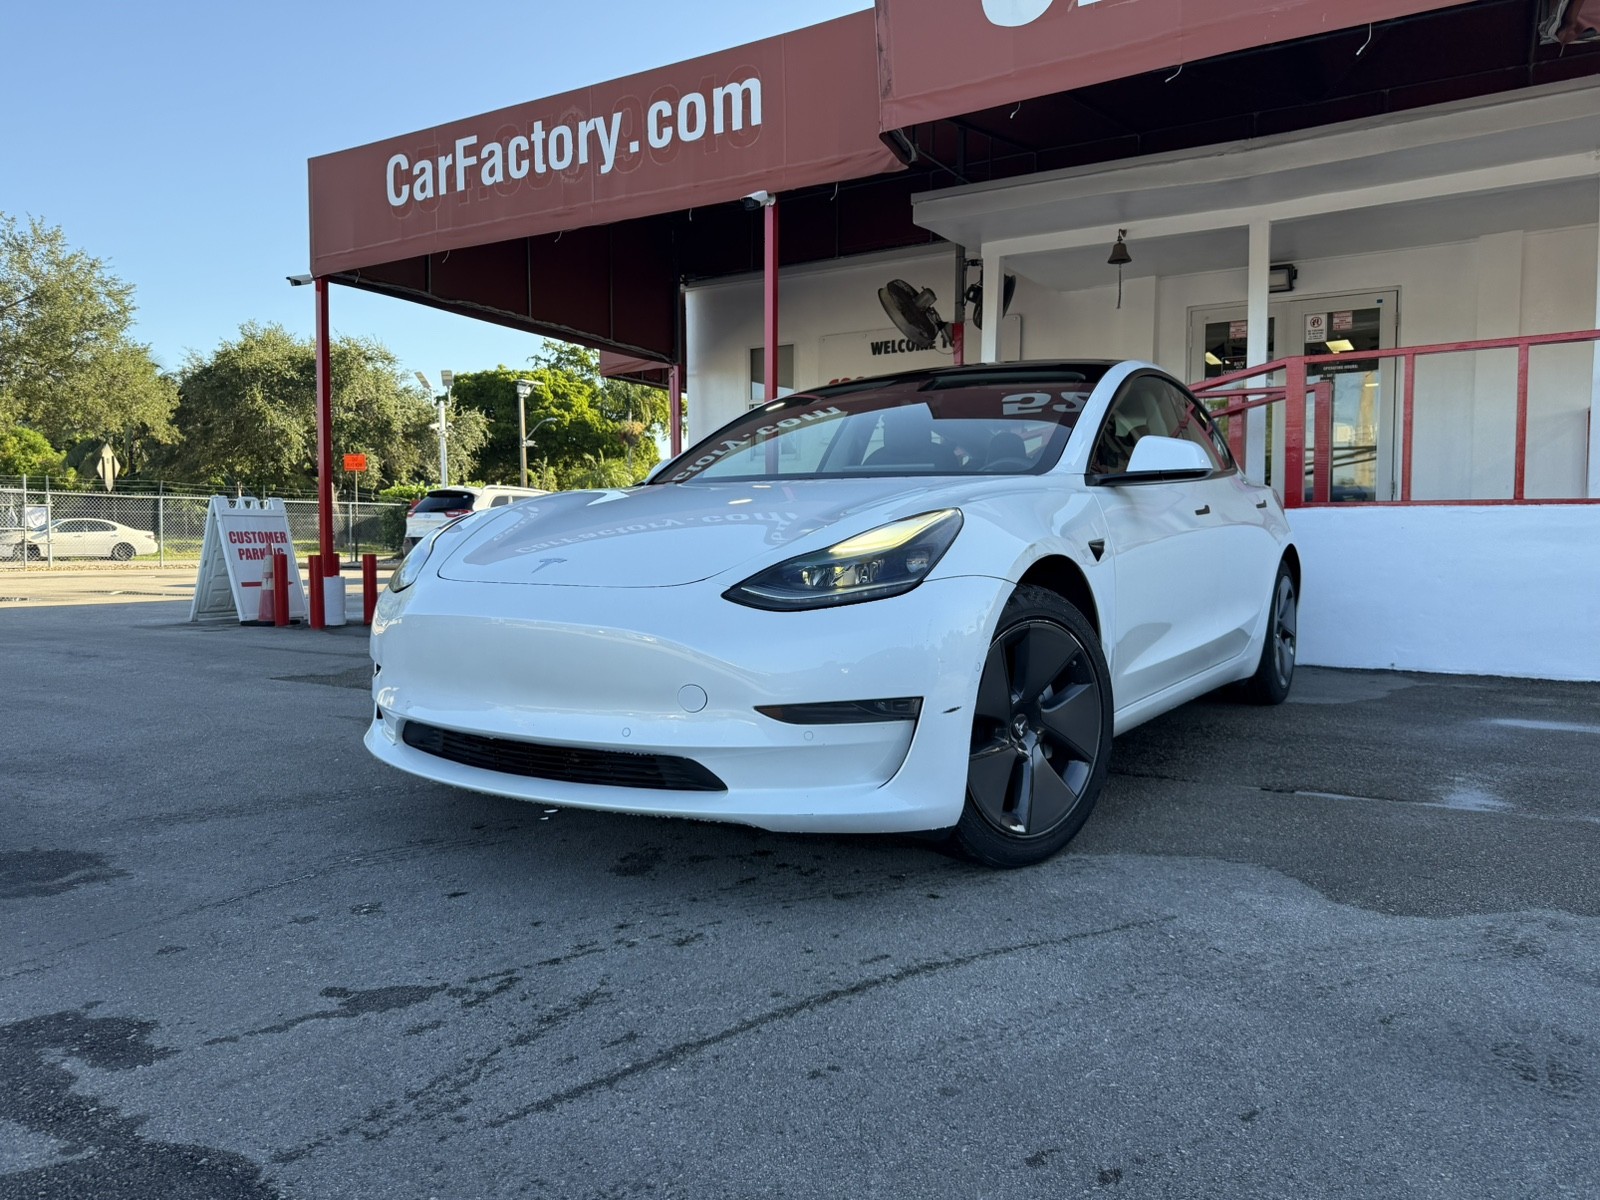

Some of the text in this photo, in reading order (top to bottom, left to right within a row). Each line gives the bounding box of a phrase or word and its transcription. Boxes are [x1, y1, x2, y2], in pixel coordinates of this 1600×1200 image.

[386, 77, 762, 207] CarFactory.com
[228, 531, 287, 544] CUSTOMER
[238, 547, 285, 560] PARKG
